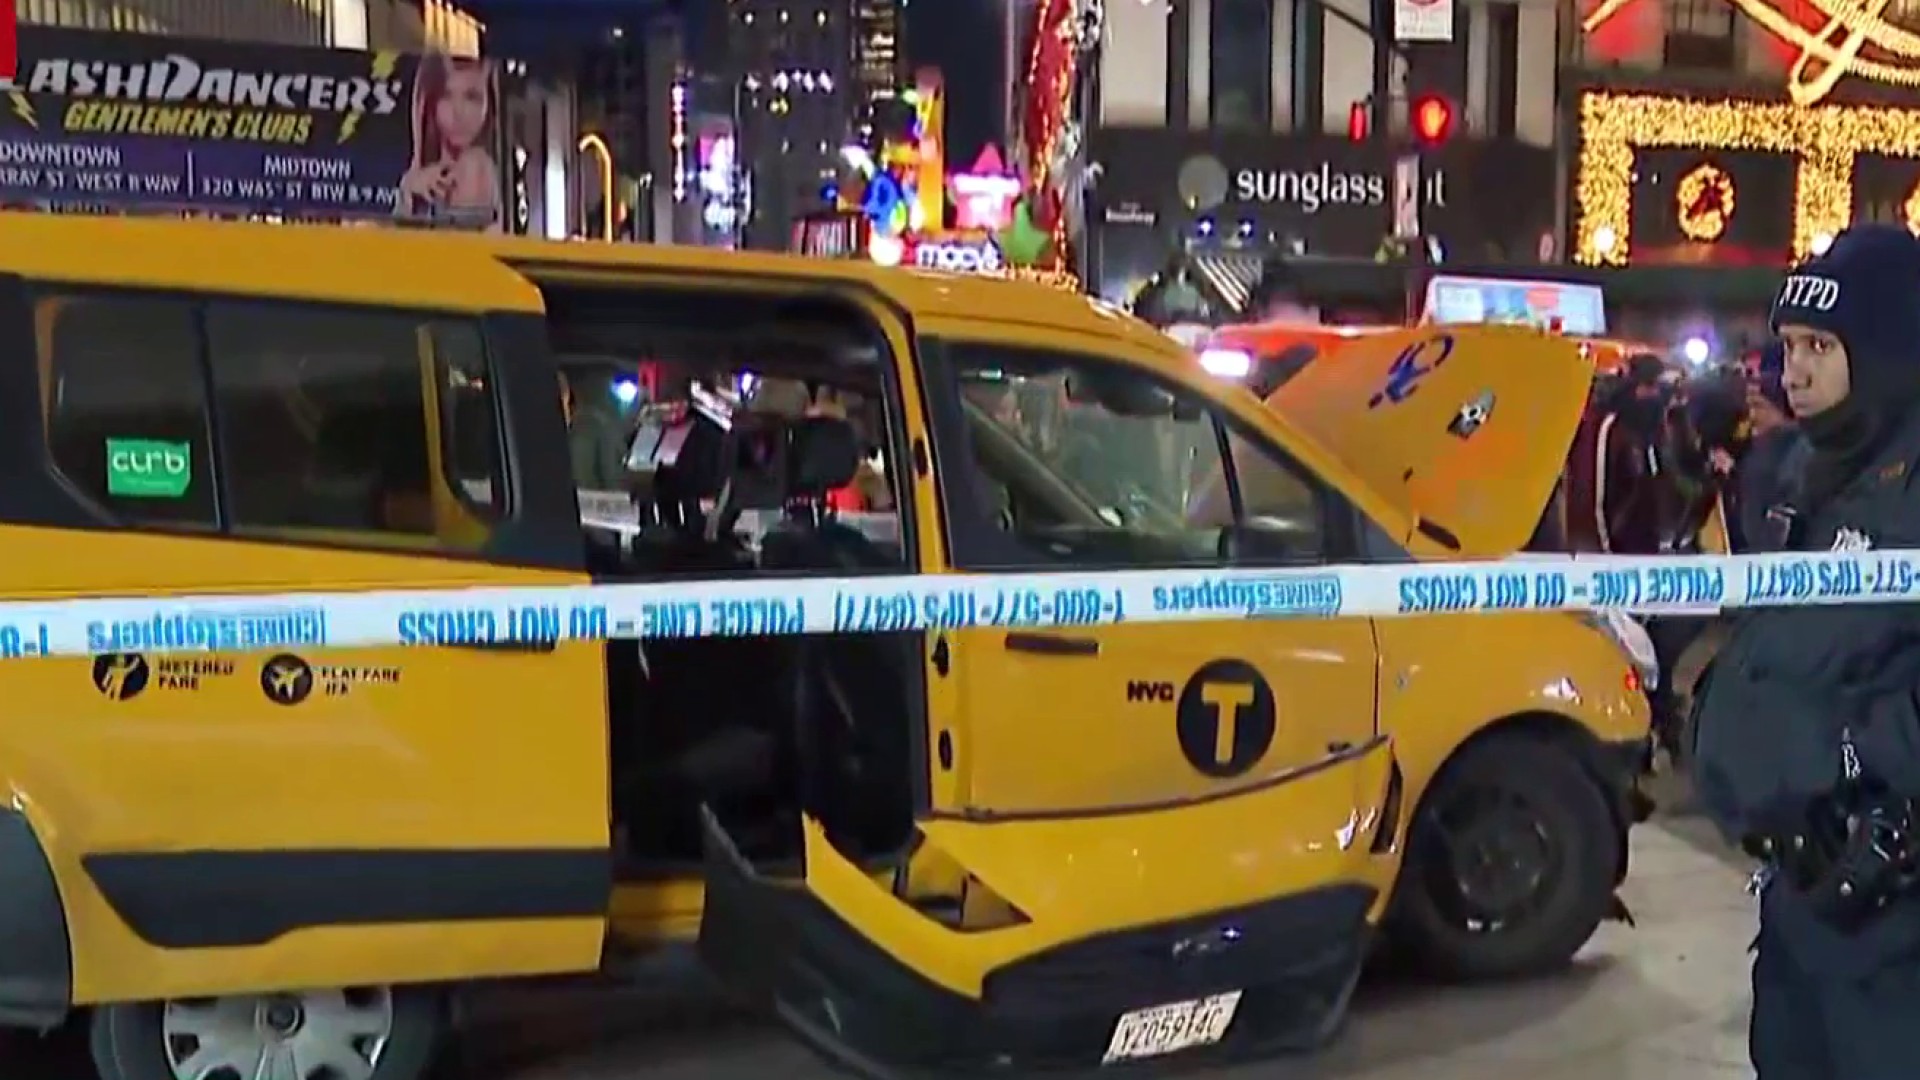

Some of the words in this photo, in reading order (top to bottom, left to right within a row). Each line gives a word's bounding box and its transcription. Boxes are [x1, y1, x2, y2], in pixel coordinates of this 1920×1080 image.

[64, 101, 232, 137] GENTLEMEN'S
[234, 110, 312, 143] CLUBS
[0, 140, 122, 167] DOWNTOWN
[264, 155, 351, 180] MIDTOWN
[1237, 161, 1384, 213] sunglass
[1779, 275, 1839, 311] NYPD
[113, 449, 185, 474] curb
[1398, 572, 1476, 613] CROSS
[1481, 572, 1529, 610] NOT
[1535, 571, 1567, 608] DO
[1590, 568, 1642, 608] LINE
[1645, 564, 1725, 605] POLICE
[397, 610, 497, 647] CROSS
[507, 605, 559, 646] NOT
[570, 606, 607, 641] DO
[643, 603, 702, 639] LINE
[711, 595, 805, 638] POLICE
[1127, 680, 1174, 702] NYC
[1202, 682, 1254, 764] T
